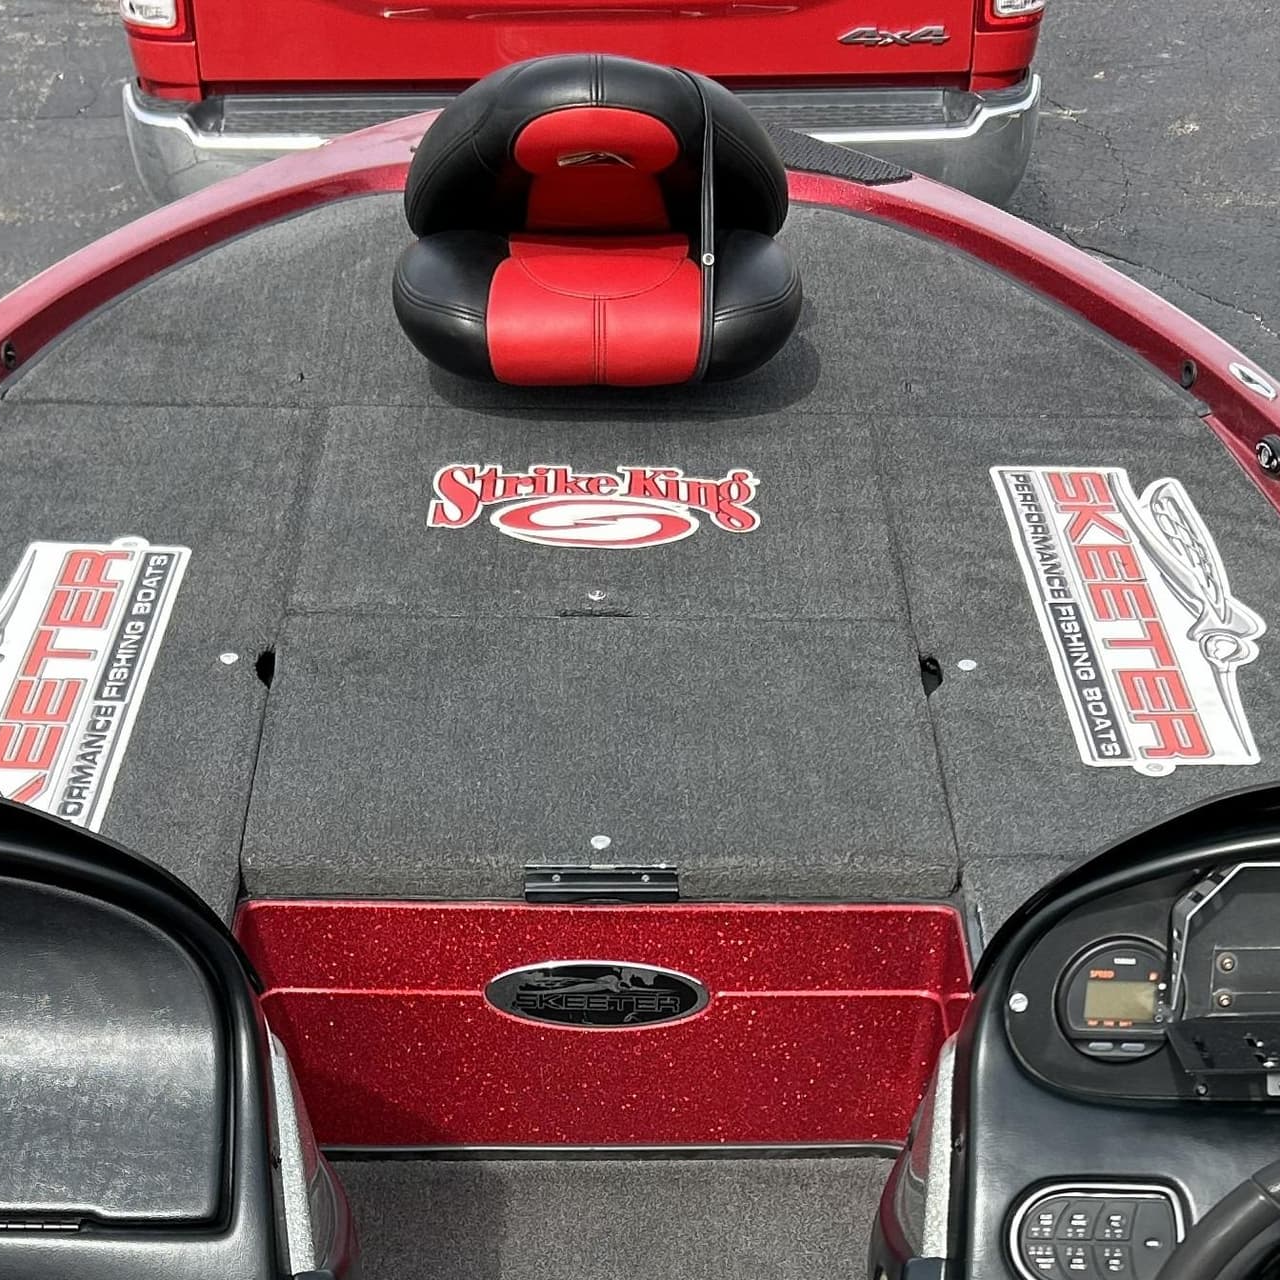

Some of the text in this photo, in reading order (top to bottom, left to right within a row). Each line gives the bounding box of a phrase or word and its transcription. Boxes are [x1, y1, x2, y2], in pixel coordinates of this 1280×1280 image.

[837, 25, 951, 46] 4x4
[432, 466, 757, 531] Strike King
[102, 620, 145, 700] FISHING
[132, 554, 169, 616] BOATS
[1009, 473, 1122, 758] PERFORMANCE FISHING BOATS
[1042, 471, 1216, 759] SKEETER
[515, 992, 681, 1013] SKEETER
